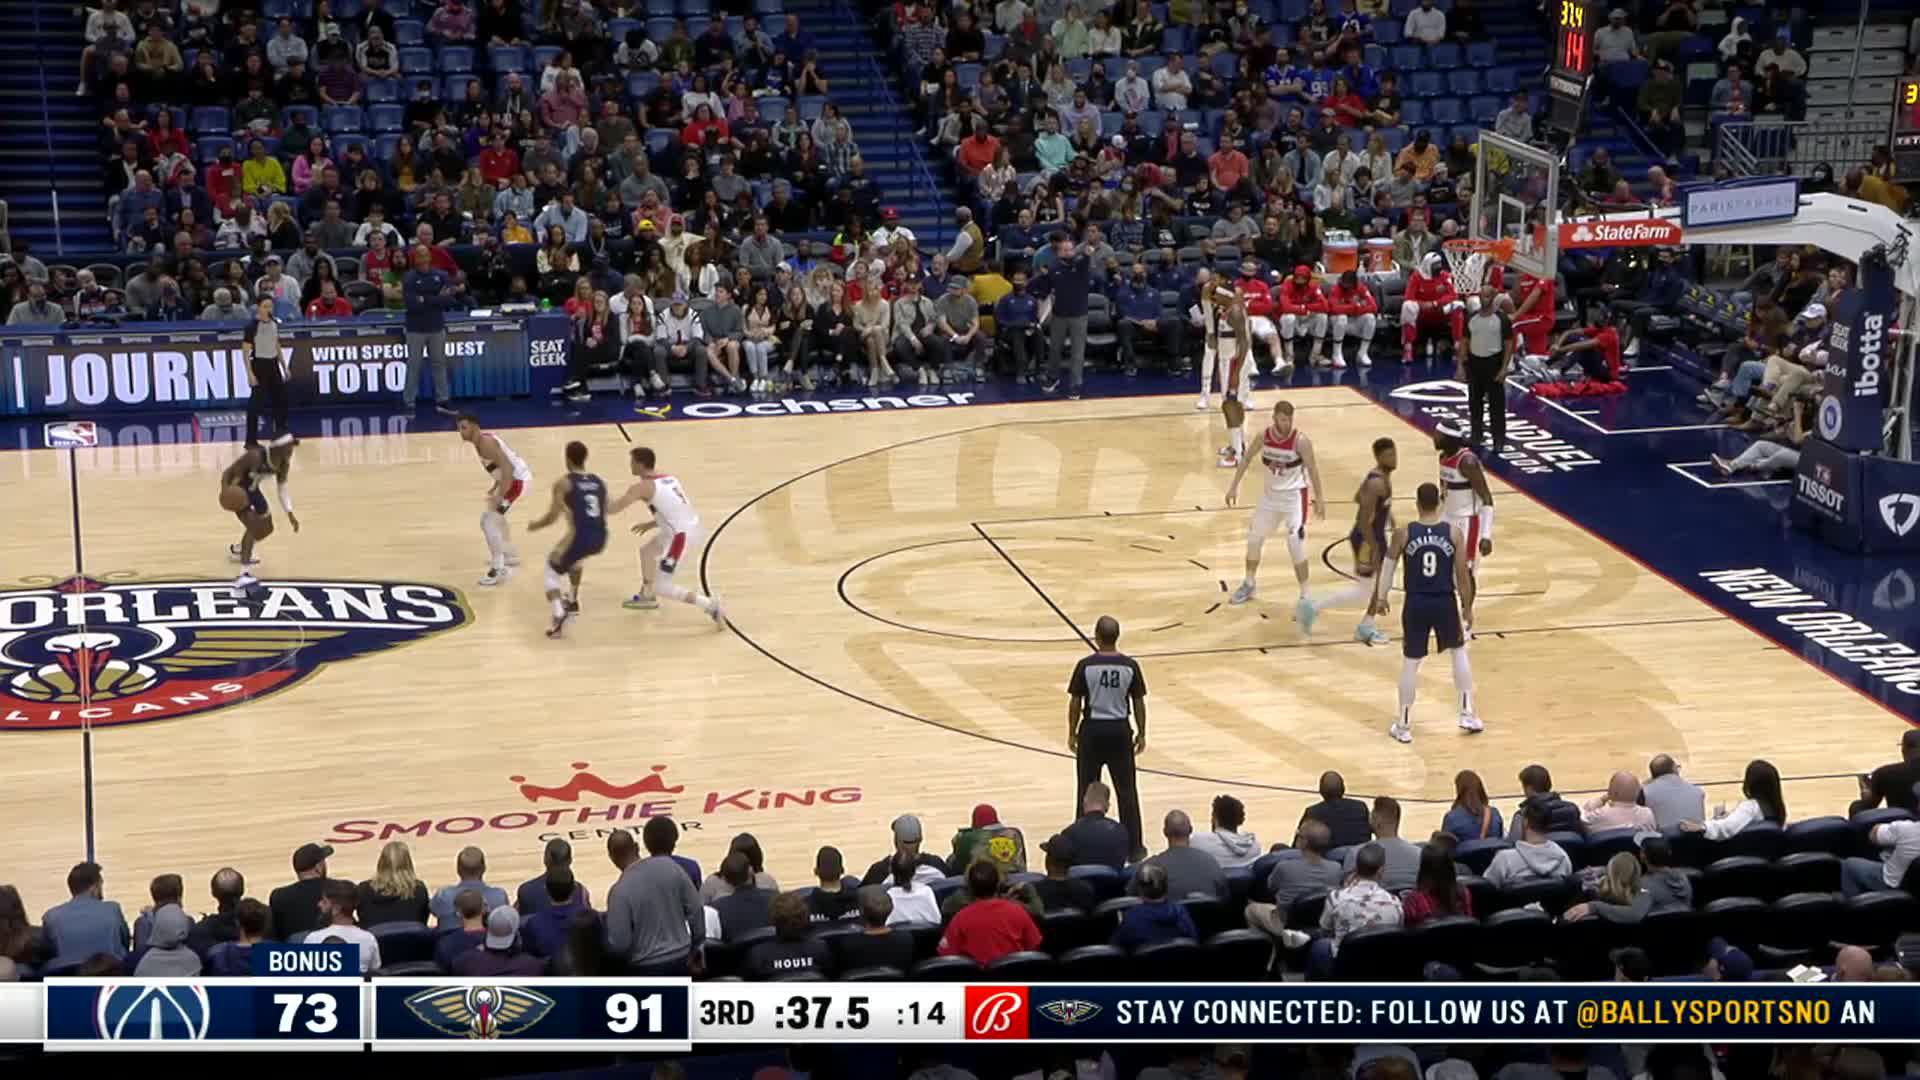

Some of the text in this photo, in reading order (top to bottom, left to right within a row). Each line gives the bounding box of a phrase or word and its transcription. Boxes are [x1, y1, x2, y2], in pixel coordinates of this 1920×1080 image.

[1564, 32, 1585, 71] 14
[312, 346, 358, 361] WITH
[444, 341, 486, 356] UEST
[529, 352, 567, 367] GEEK
[530, 339, 565, 353] SEAT
[1854, 314, 1884, 397] ibotta
[45, 347, 293, 406] JOURN
[313, 362, 408, 394] TOTO
[682, 392, 974, 418] Ochsner
[584, 493, 600, 517] 3
[1798, 473, 1845, 512] TISSOT
[1423, 551, 1437, 577] 9
[1698, 567, 1828, 608] NEW
[0, 586, 454, 630] ORLEANS
[325, 800, 677, 844] SMOOTHIE
[538, 820, 704, 843] CENTR
[773, 956, 813, 969] HOUSE
